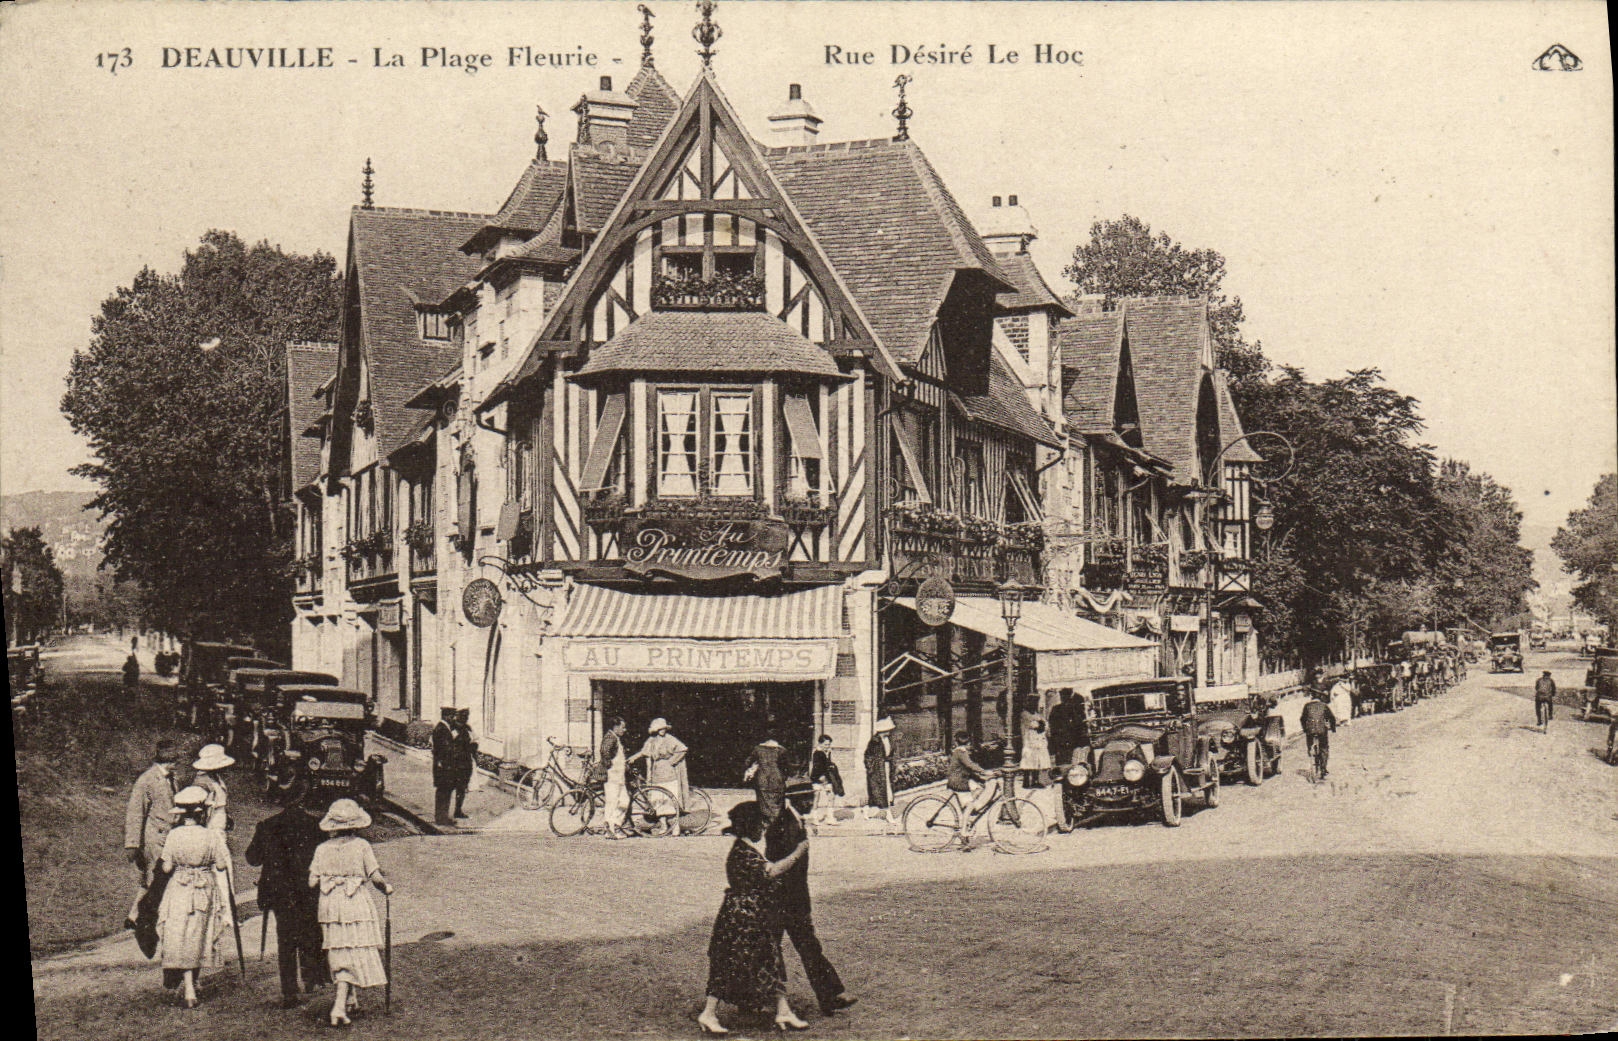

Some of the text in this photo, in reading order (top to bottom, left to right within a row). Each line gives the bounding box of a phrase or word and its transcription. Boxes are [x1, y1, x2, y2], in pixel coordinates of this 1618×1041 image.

[700, 522, 758, 546] Au
[627, 527, 784, 573] Printemps
[584, 646, 813, 670] AU PRINTEMPS
